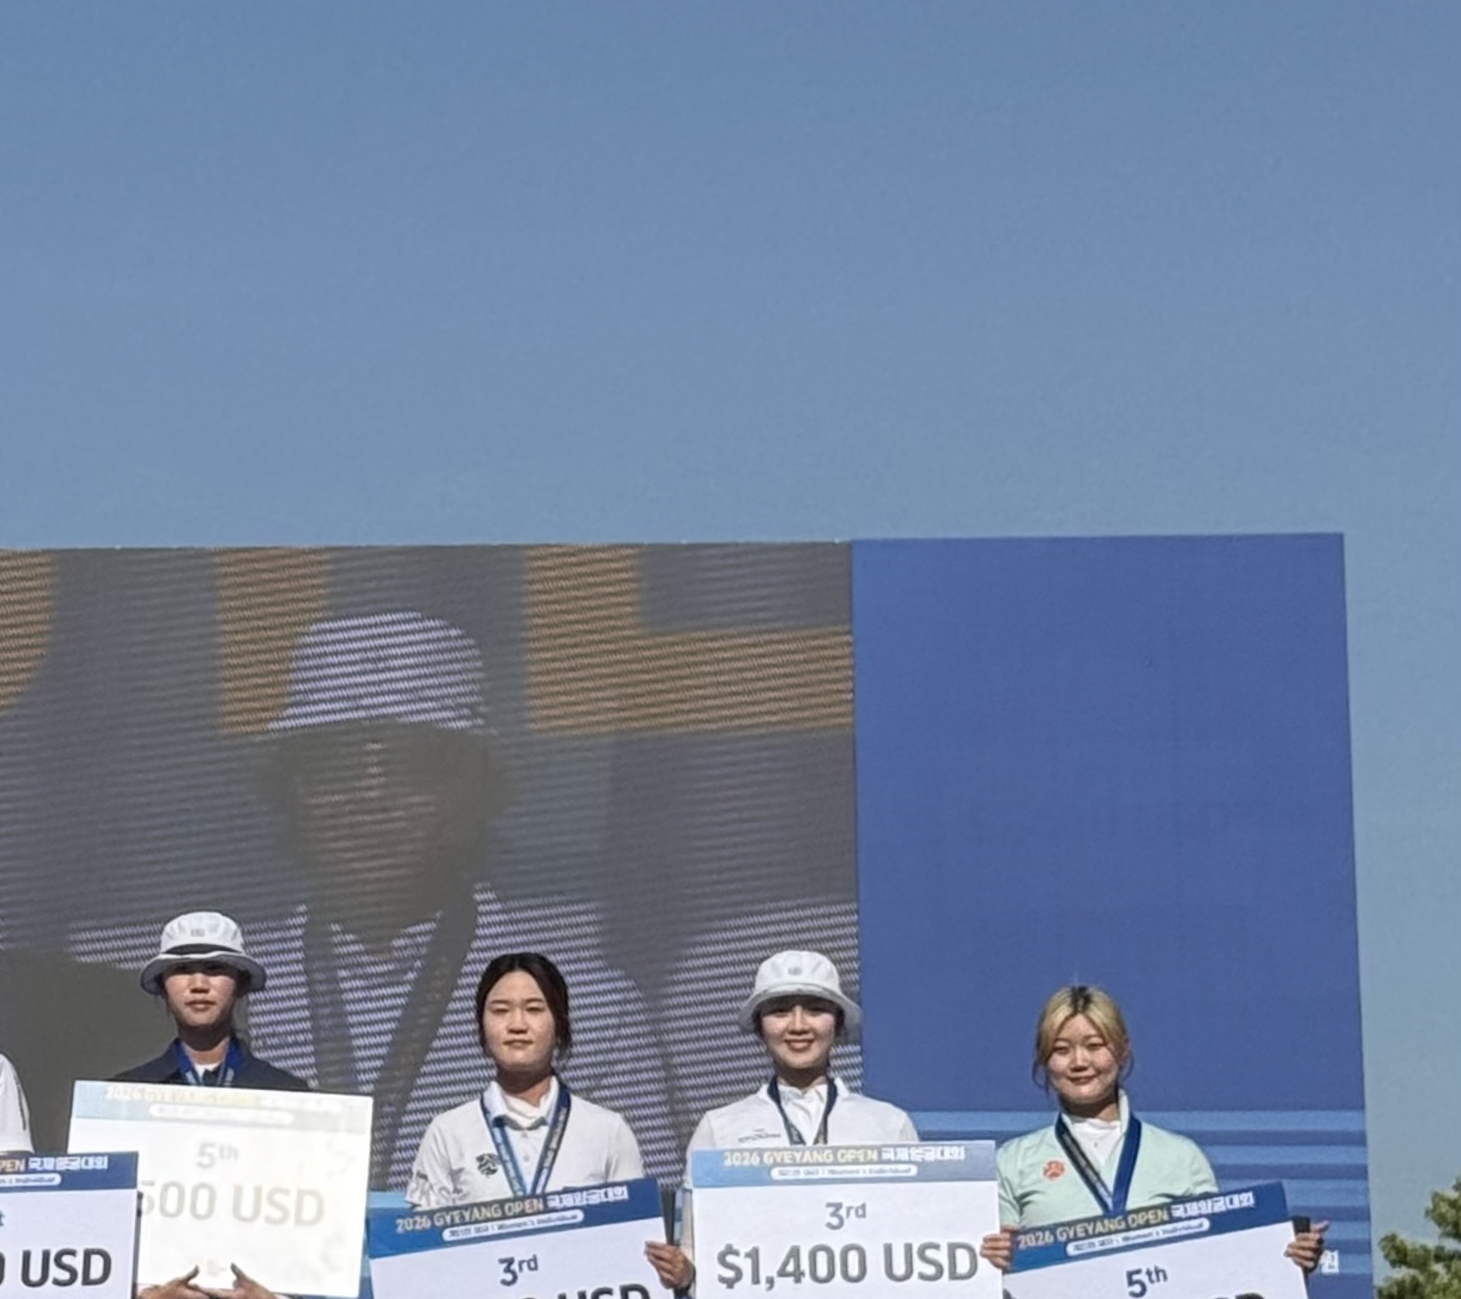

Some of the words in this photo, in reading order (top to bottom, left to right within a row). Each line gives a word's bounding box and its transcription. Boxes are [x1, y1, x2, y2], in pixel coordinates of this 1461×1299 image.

[197, 1141, 239, 1169] 5th
[723, 1151, 759, 1166] 2026
[762, 1150, 833, 1165] GYEYANG
[837, 1148, 878, 1163] OPEN
[139, 1179, 217, 1221] 500
[231, 1183, 325, 1228] USD
[396, 1215, 431, 1233] 2026
[434, 1204, 502, 1227] GYEYANG
[505, 1198, 544, 1217] OPEN
[825, 1202, 867, 1230] 3rd
[1018, 1231, 1054, 1249] 2026
[1057, 1216, 1125, 1240] GYEYANG
[1128, 1209, 1169, 1228] OPEN
[21, 1248, 112, 1288] USD
[498, 1254, 539, 1286] 3rd
[716, 1242, 867, 1290] $1,400
[883, 1241, 978, 1282] USD
[1126, 1266, 1168, 1298] 5th
